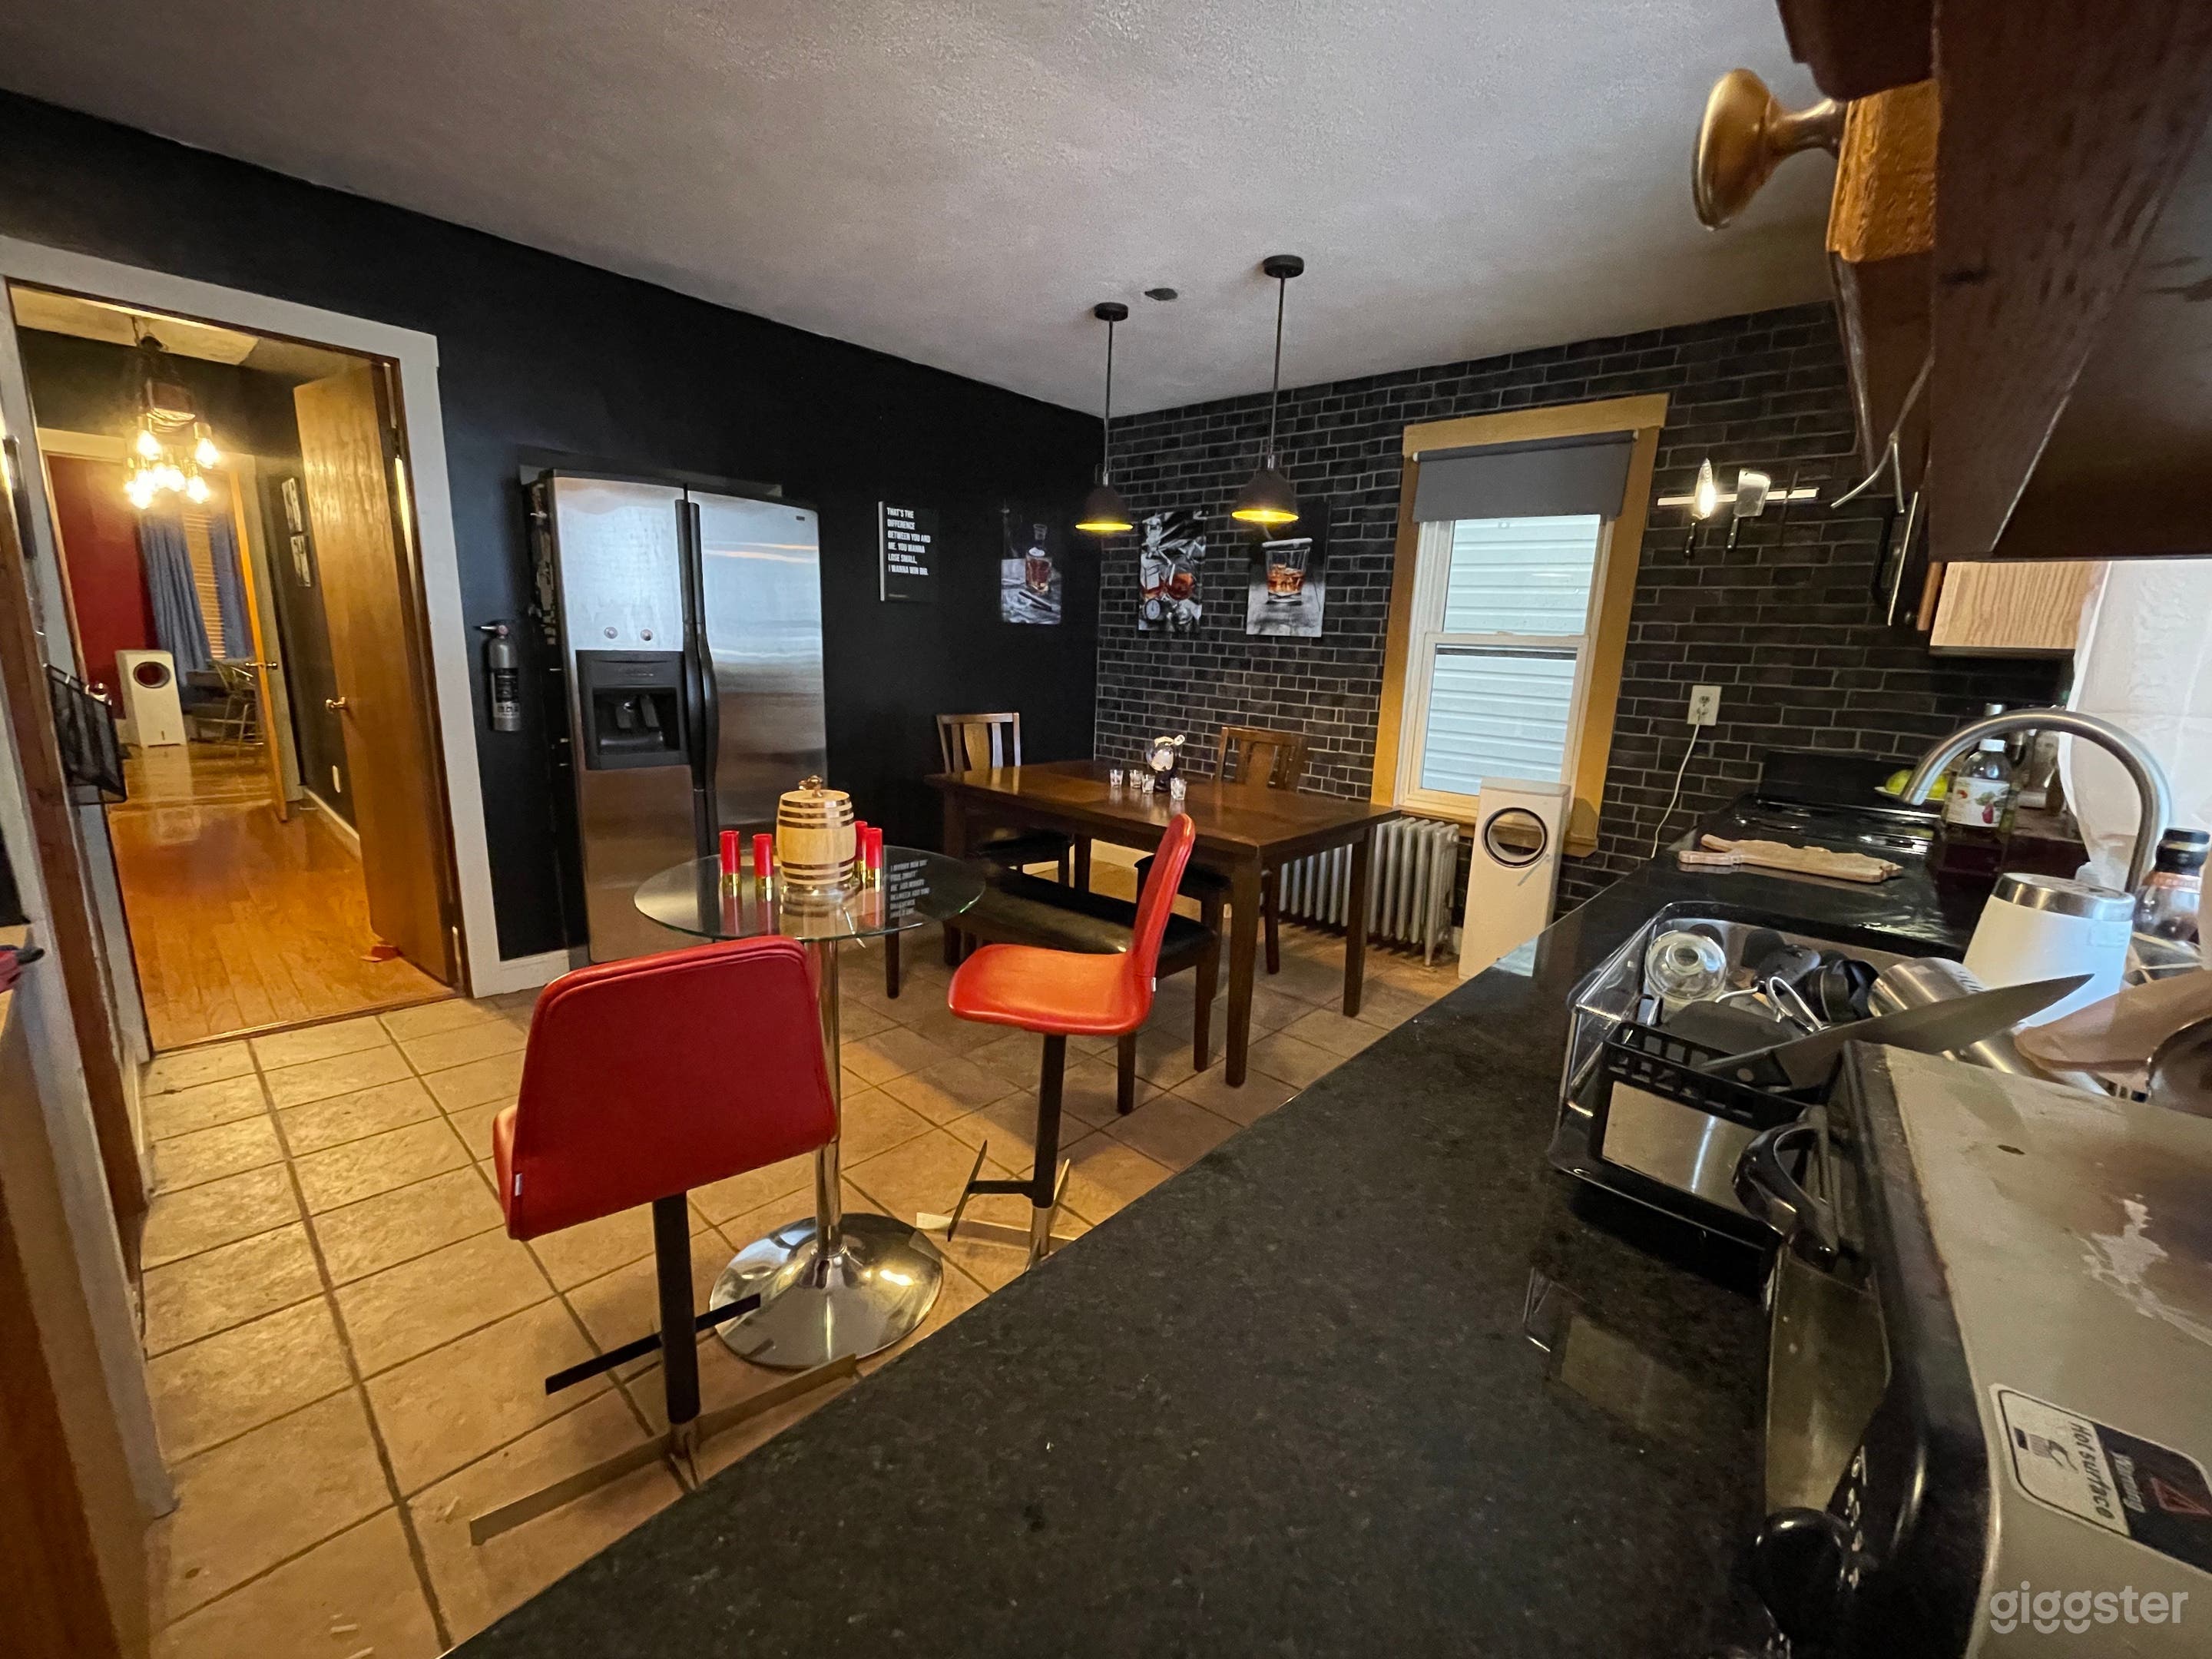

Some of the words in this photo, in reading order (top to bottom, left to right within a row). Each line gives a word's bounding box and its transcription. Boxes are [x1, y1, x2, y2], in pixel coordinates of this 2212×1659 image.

[905, 510, 914, 518] THE
[2069, 1422, 2095, 1452] Hot
[2079, 1450, 2115, 1519] surface
